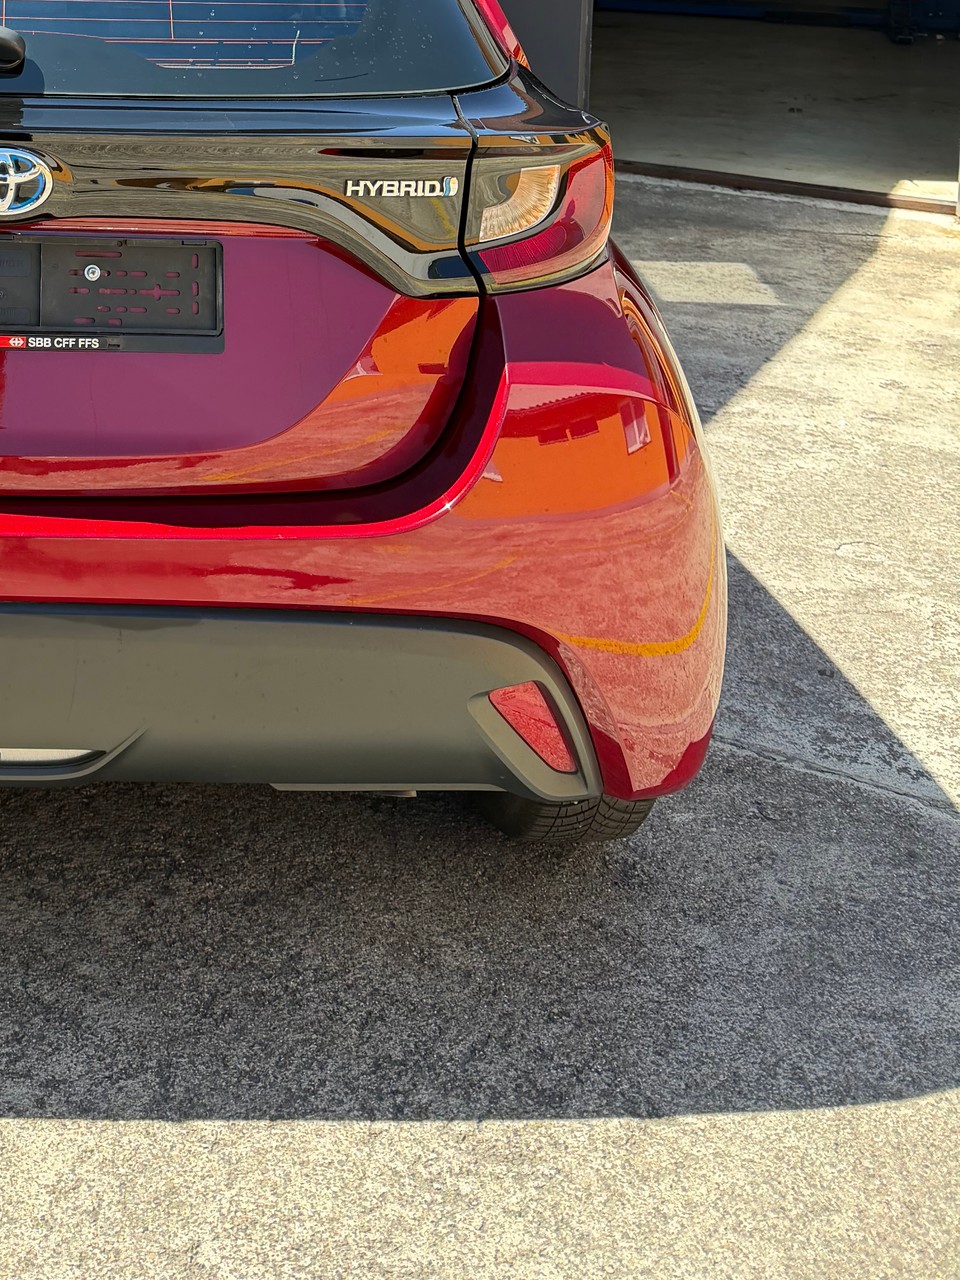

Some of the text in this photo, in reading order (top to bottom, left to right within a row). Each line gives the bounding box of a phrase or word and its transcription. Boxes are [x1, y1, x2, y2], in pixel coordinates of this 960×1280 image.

[346, 180, 443, 197] HYBRID
[28, 337, 99, 348] SBB CFF FFS
